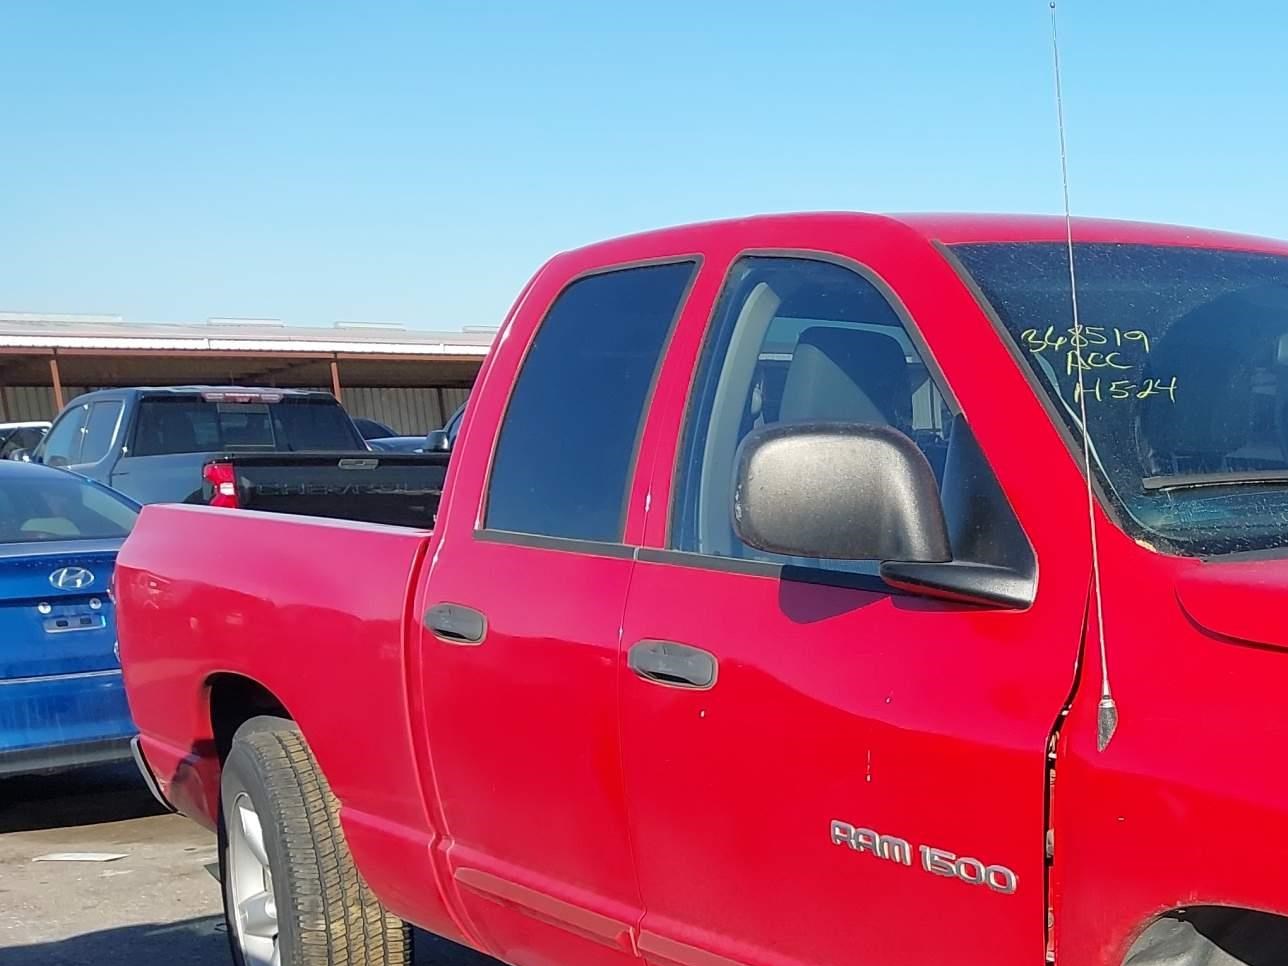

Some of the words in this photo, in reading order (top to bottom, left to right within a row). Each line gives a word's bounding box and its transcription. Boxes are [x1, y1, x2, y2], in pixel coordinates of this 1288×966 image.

[1067, 350, 1135, 375] ACC
[830, 819, 913, 866] RAM
[919, 844, 1018, 895] 1500
